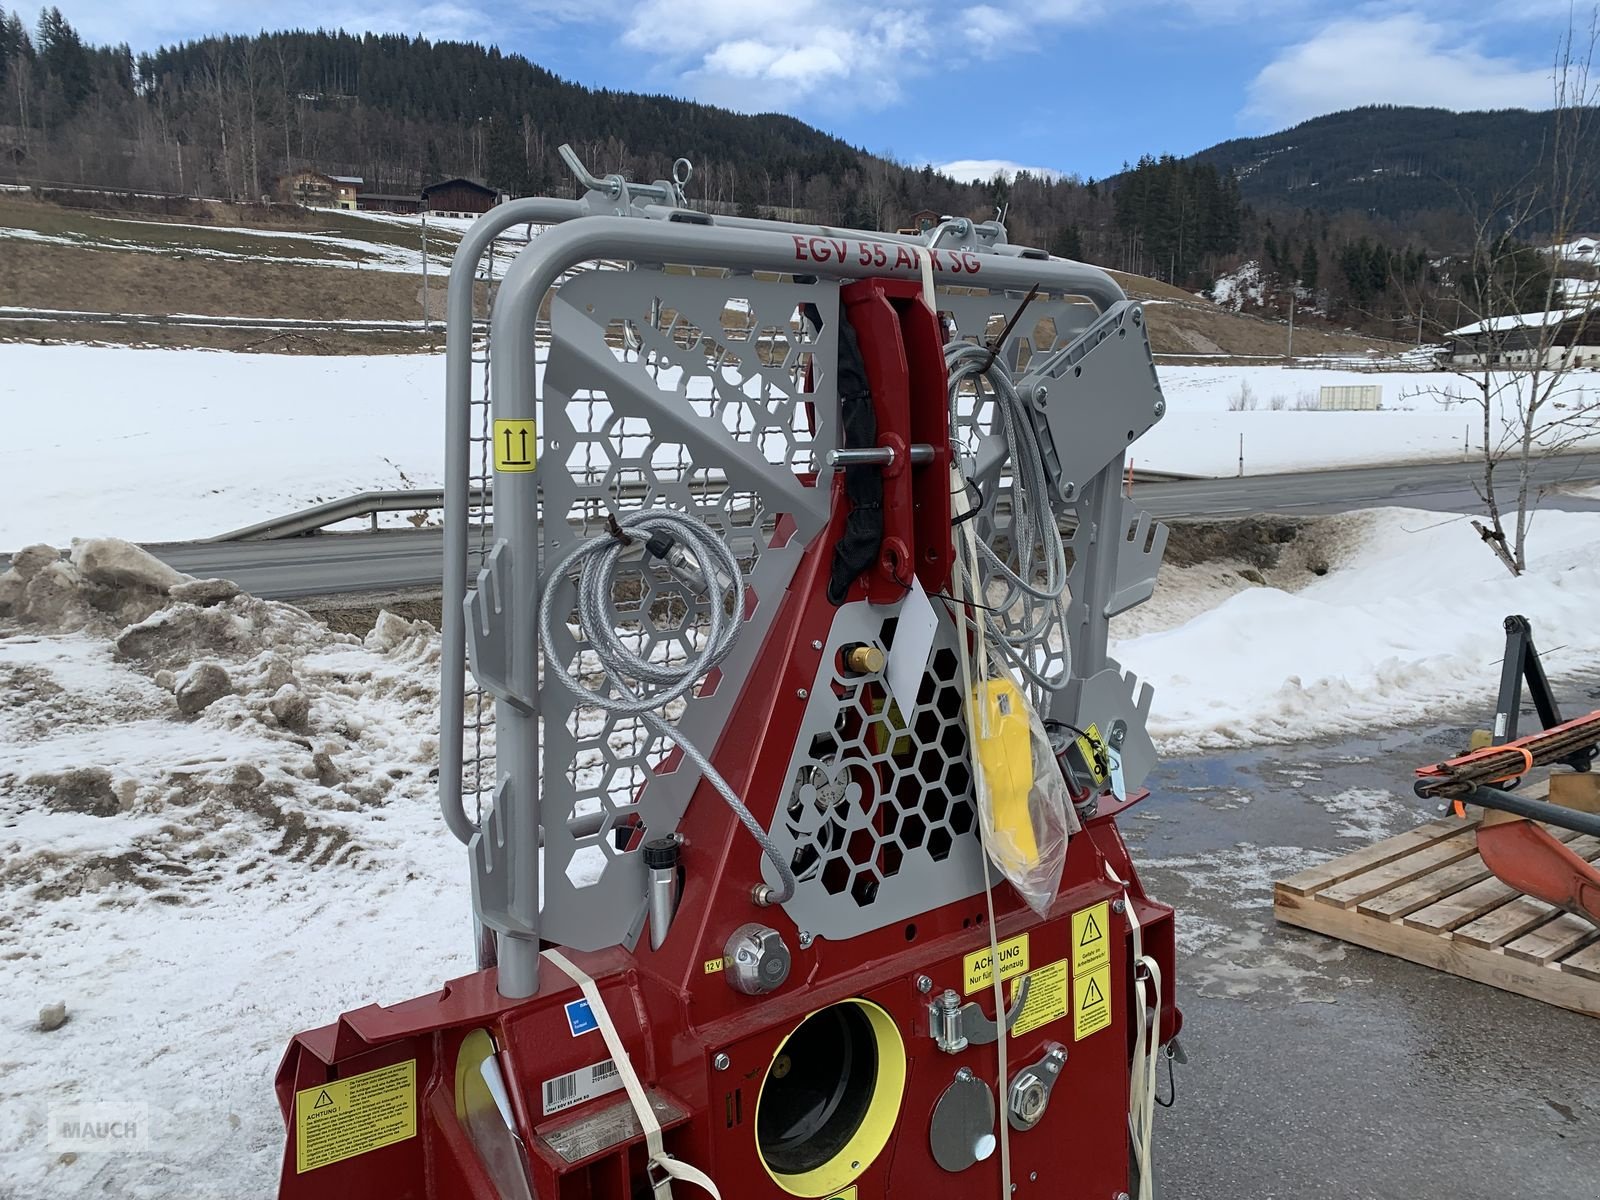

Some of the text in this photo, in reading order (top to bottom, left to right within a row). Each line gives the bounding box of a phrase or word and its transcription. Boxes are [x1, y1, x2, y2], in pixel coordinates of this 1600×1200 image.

[792, 235, 847, 263] EGV
[858, 242, 887, 267] 55
[948, 251, 981, 274] SG
[706, 961, 720, 971] 12 V
[973, 945, 1020, 972] ACHUNG
[969, 959, 1024, 986] Nur für denzug
[306, 1107, 338, 1121] ACHTUNG
